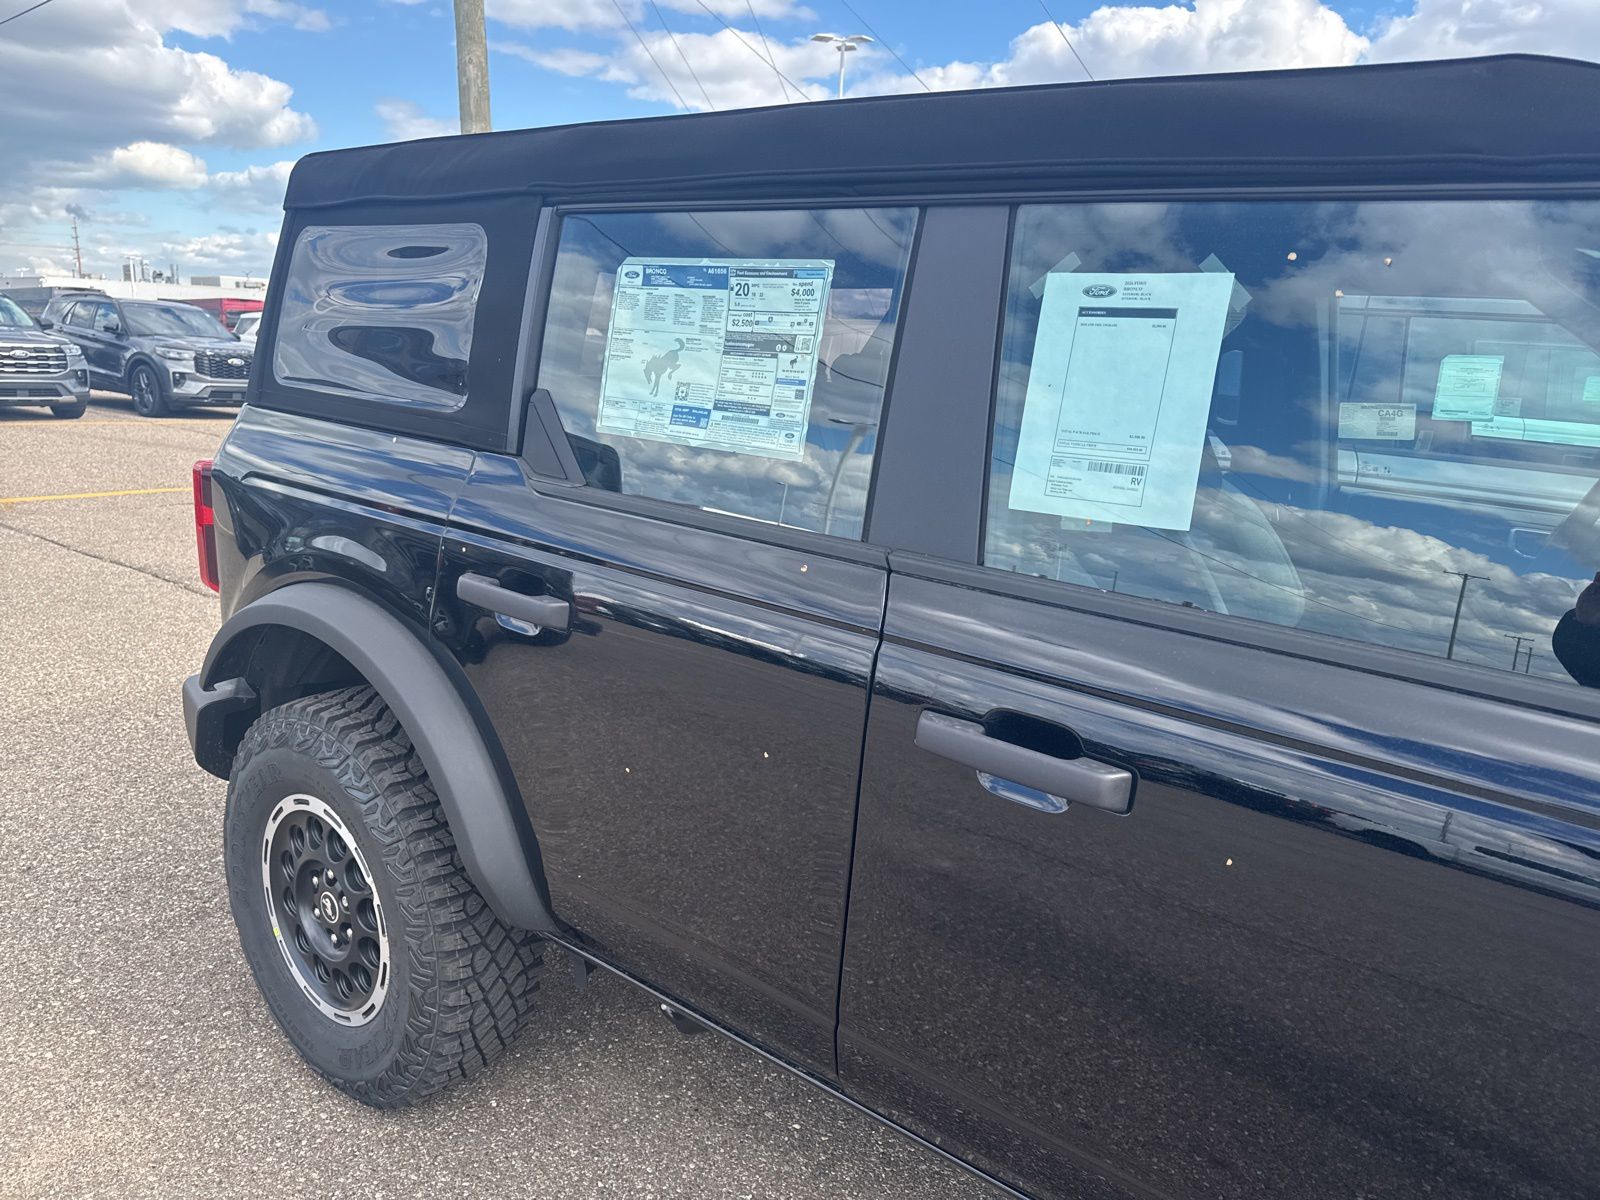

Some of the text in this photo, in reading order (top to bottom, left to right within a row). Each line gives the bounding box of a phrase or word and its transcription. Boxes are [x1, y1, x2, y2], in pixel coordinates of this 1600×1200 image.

[735, 282, 750, 297] 20
[790, 288, 815, 297] $4,000
[731, 319, 753, 328] $2,500
[1378, 409, 1404, 418] CA4G
[1130, 477, 1142, 486] RV
